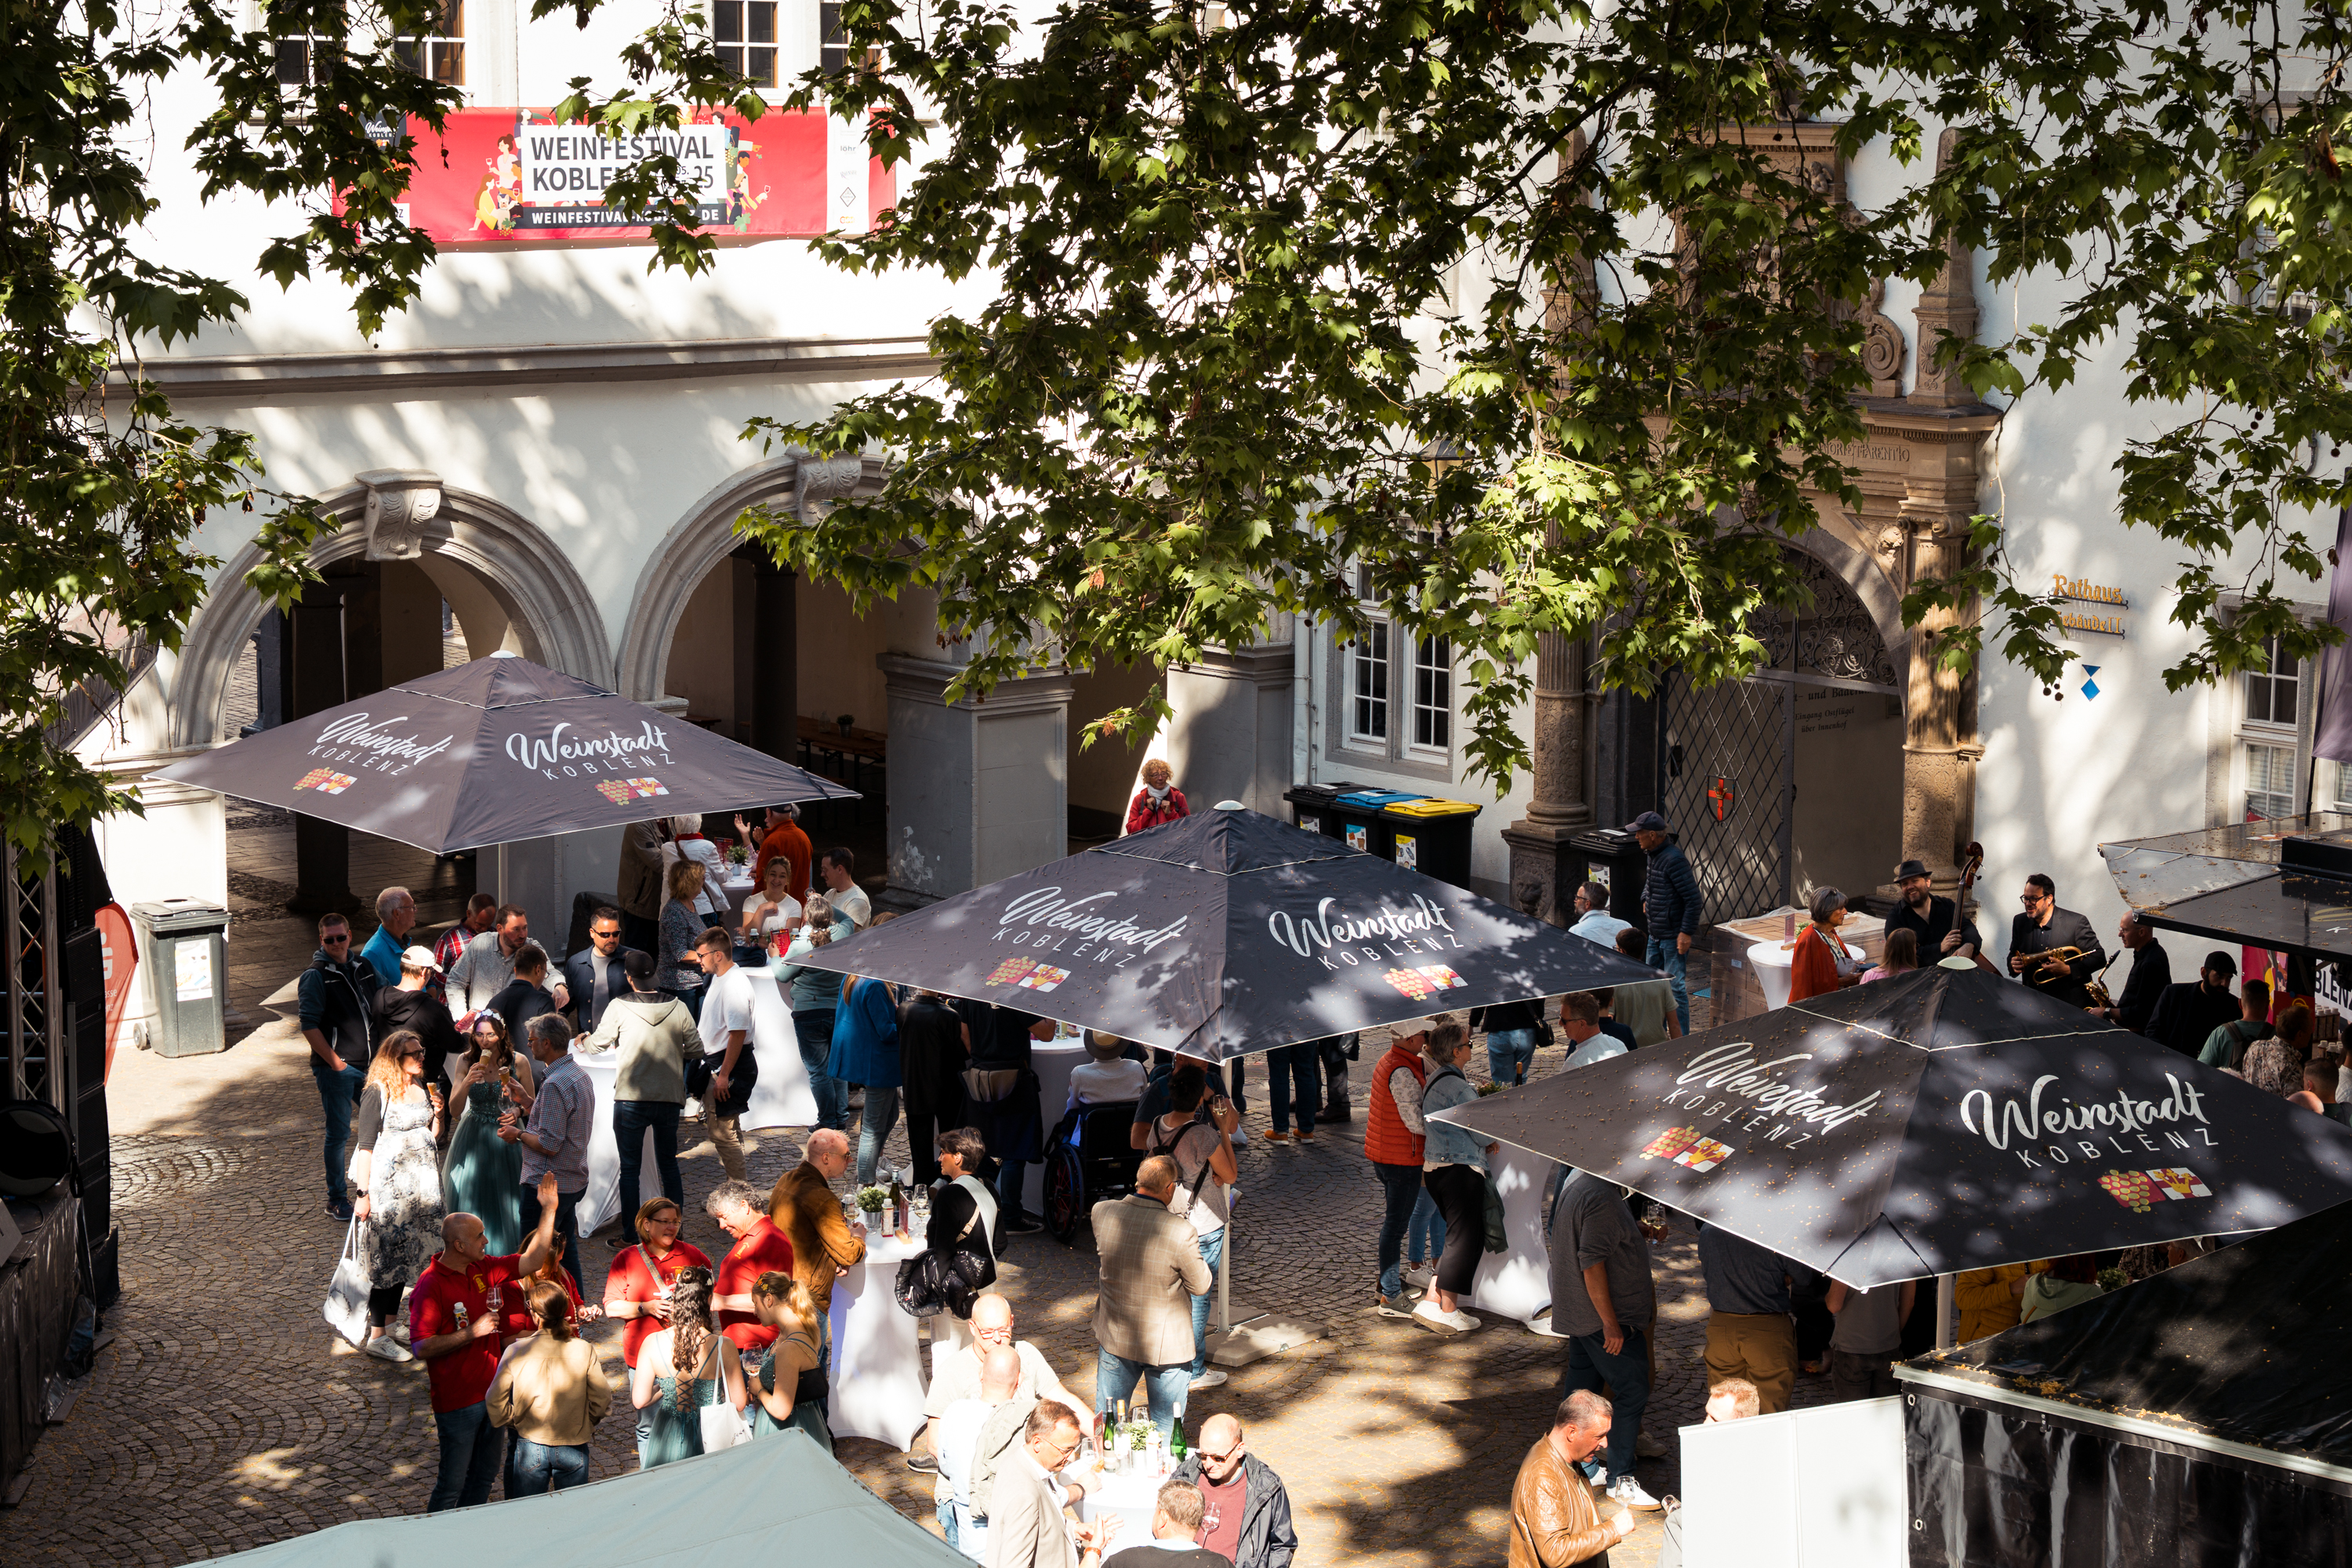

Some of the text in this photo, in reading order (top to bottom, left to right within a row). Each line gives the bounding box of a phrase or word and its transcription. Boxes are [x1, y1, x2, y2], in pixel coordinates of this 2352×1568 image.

[531, 136, 714, 161] WEINFESTIVAL
[2053, 574, 2124, 604] Rathaus
[1795, 706, 1856, 722] Eingang Ostflügel
[1808, 688, 1827, 700] und
[316, 712, 454, 765] Weinstadt
[505, 720, 671, 770] Weinstadt
[1801, 720, 1848, 733] über Innenhof
[307, 746, 409, 776] KOBLENZ
[541, 753, 676, 781] KOBLENZ
[999, 886, 1189, 955] Weinstadt
[1268, 893, 1455, 957] Weinstadt
[991, 927, 1137, 968] KOBLENZ
[1317, 934, 1465, 971] KOBLENZ
[1675, 1042, 1882, 1136] Weinstadt
[1661, 1087, 1813, 1150] KOBLENZ
[1959, 1073, 2211, 1150] Weinstadt
[2015, 1127, 2220, 1168] KOBLENZ
